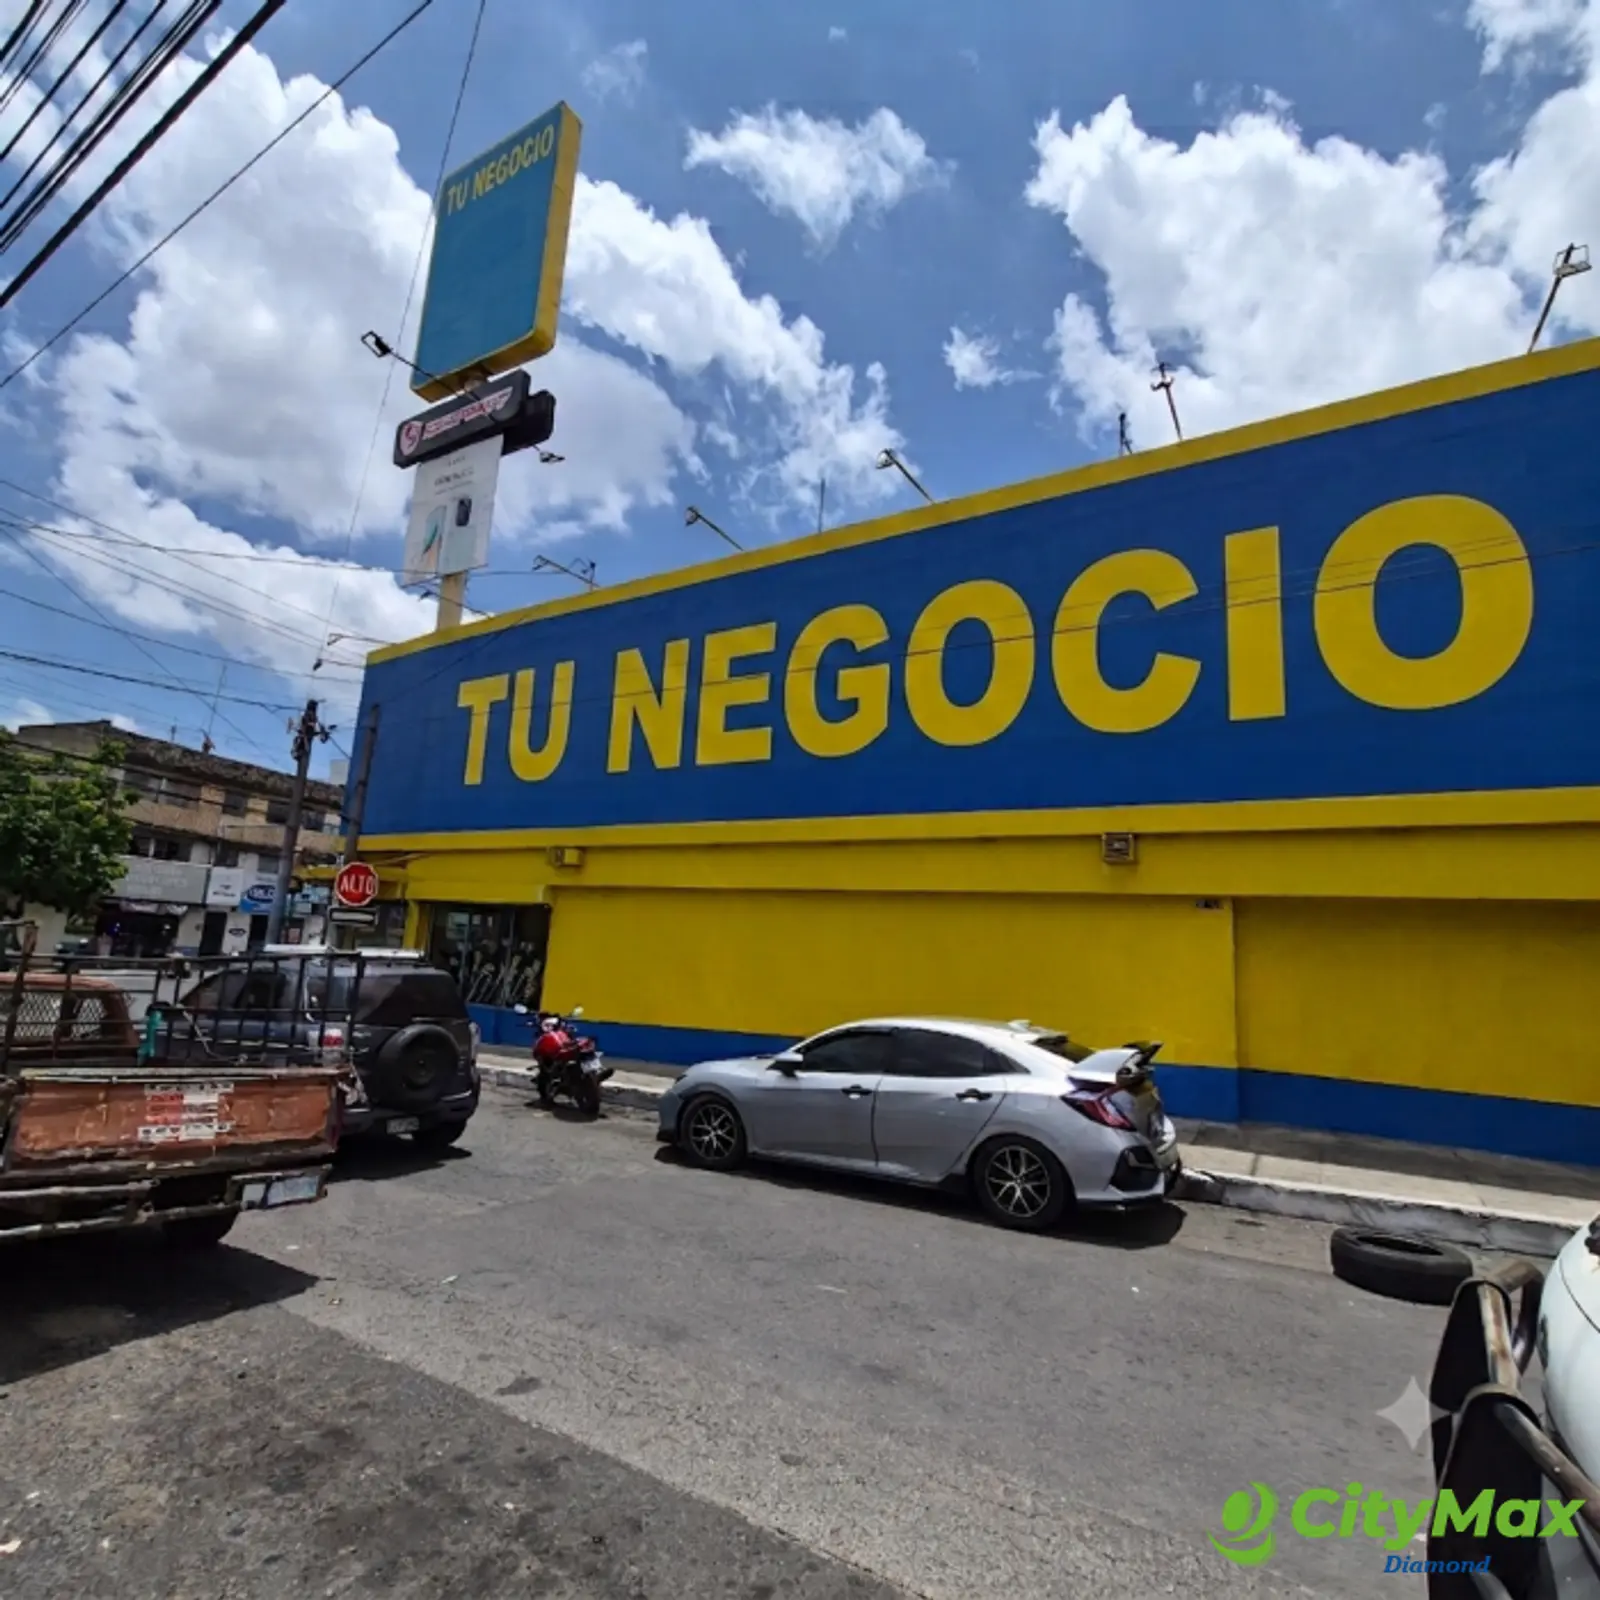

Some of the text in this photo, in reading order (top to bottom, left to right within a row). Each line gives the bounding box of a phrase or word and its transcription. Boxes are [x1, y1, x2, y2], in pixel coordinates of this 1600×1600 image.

[447, 123, 555, 216] TU NEGOCIO
[457, 494, 1534, 787] TU NEGOCIO
[340, 873, 374, 896] ALTO
